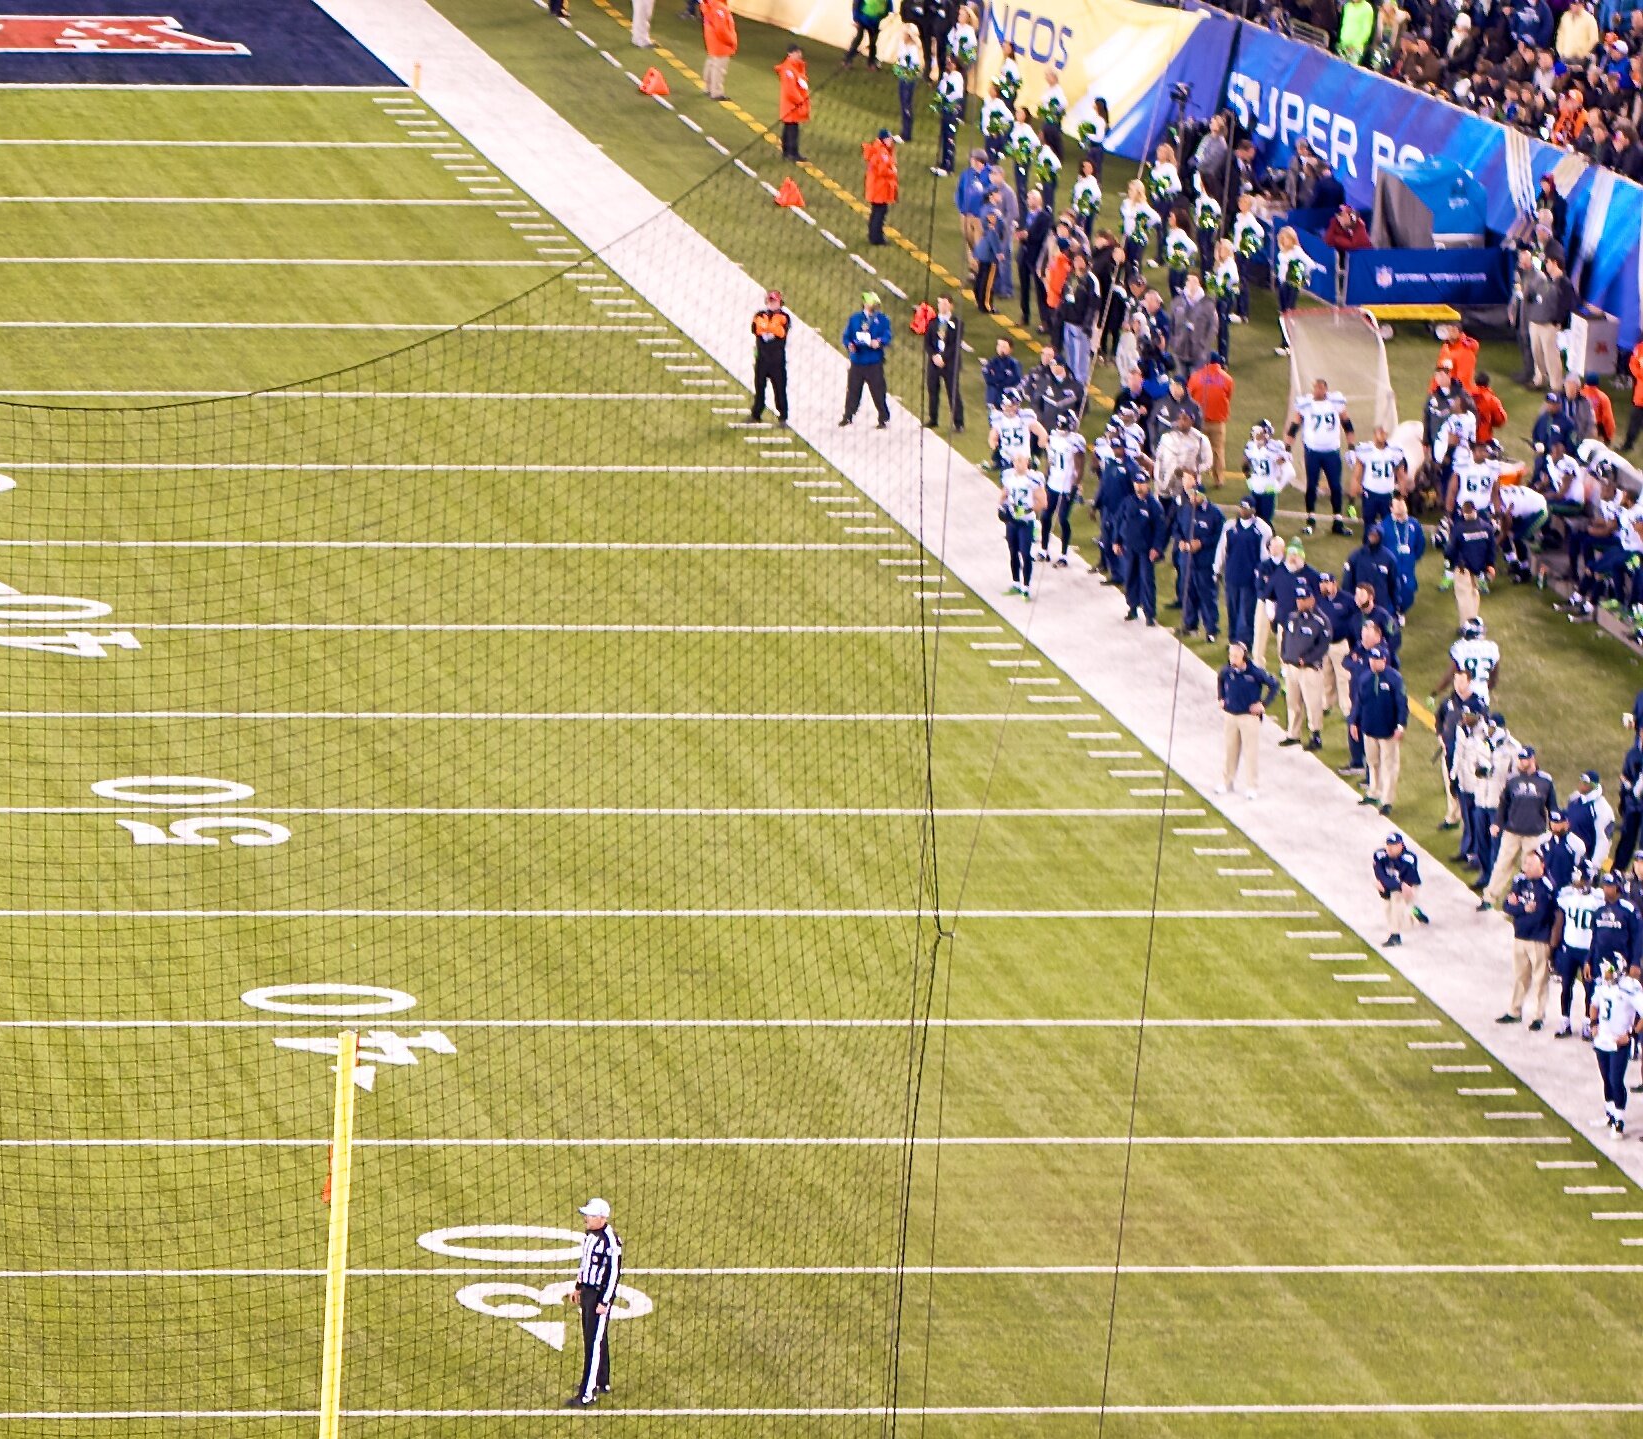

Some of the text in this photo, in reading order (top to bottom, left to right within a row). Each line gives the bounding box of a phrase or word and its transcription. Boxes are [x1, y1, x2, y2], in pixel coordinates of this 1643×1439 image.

[1228, 71, 1358, 179] SUPER
[91, 775, 292, 846] 50
[240, 983, 457, 1065] 40
[416, 1223, 653, 1320] 30
